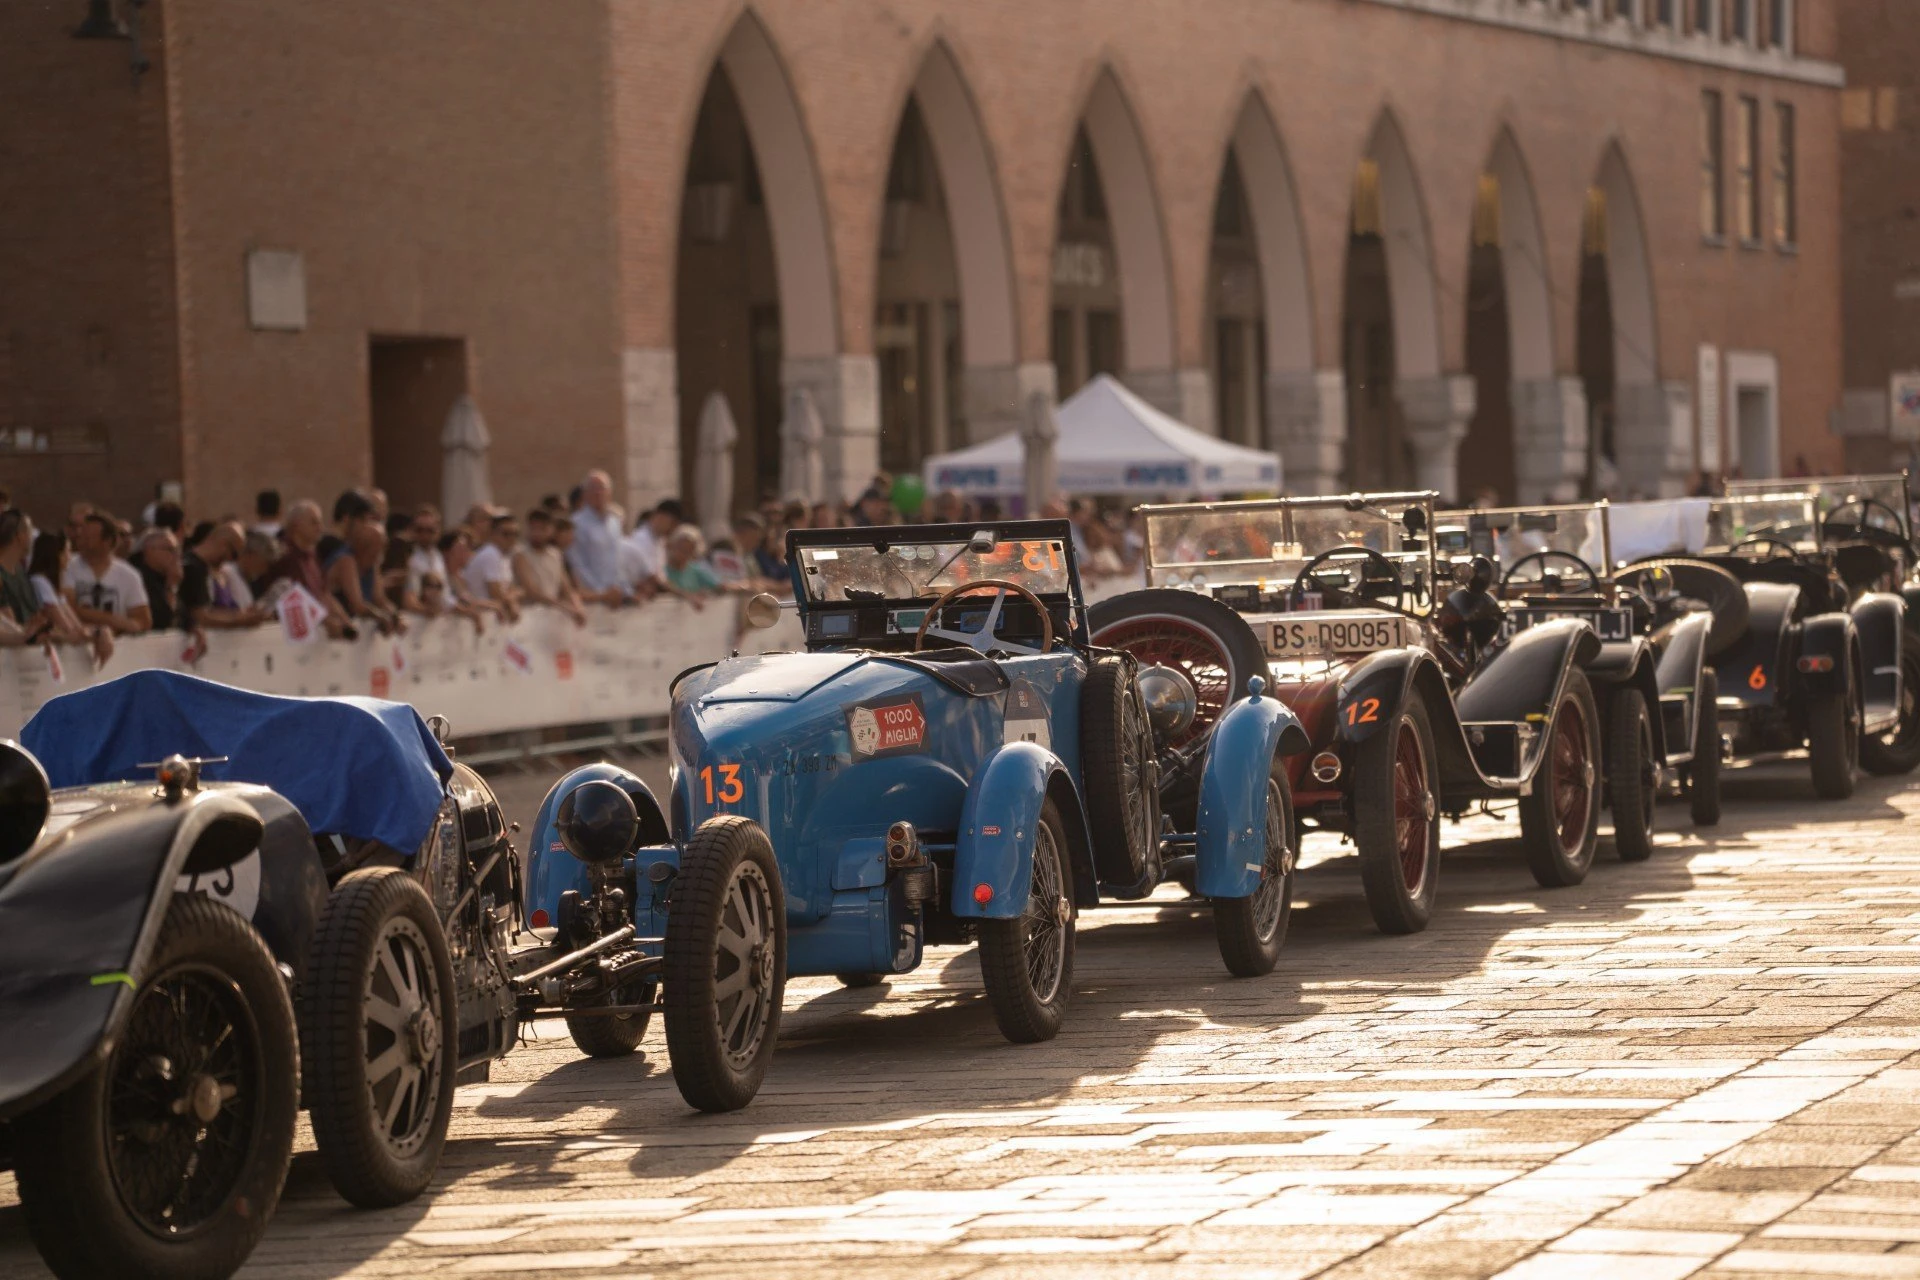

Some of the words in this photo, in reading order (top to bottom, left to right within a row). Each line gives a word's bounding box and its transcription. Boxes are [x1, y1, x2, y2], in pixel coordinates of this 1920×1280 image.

[1273, 624, 1305, 650] BS
[1318, 621, 1401, 650] D90951
[1748, 664, 1767, 690] 6
[883, 708, 914, 725] 1000
[1345, 697, 1380, 727] 12
[885, 726, 919, 745] MIGLIA
[700, 764, 744, 804] 13
